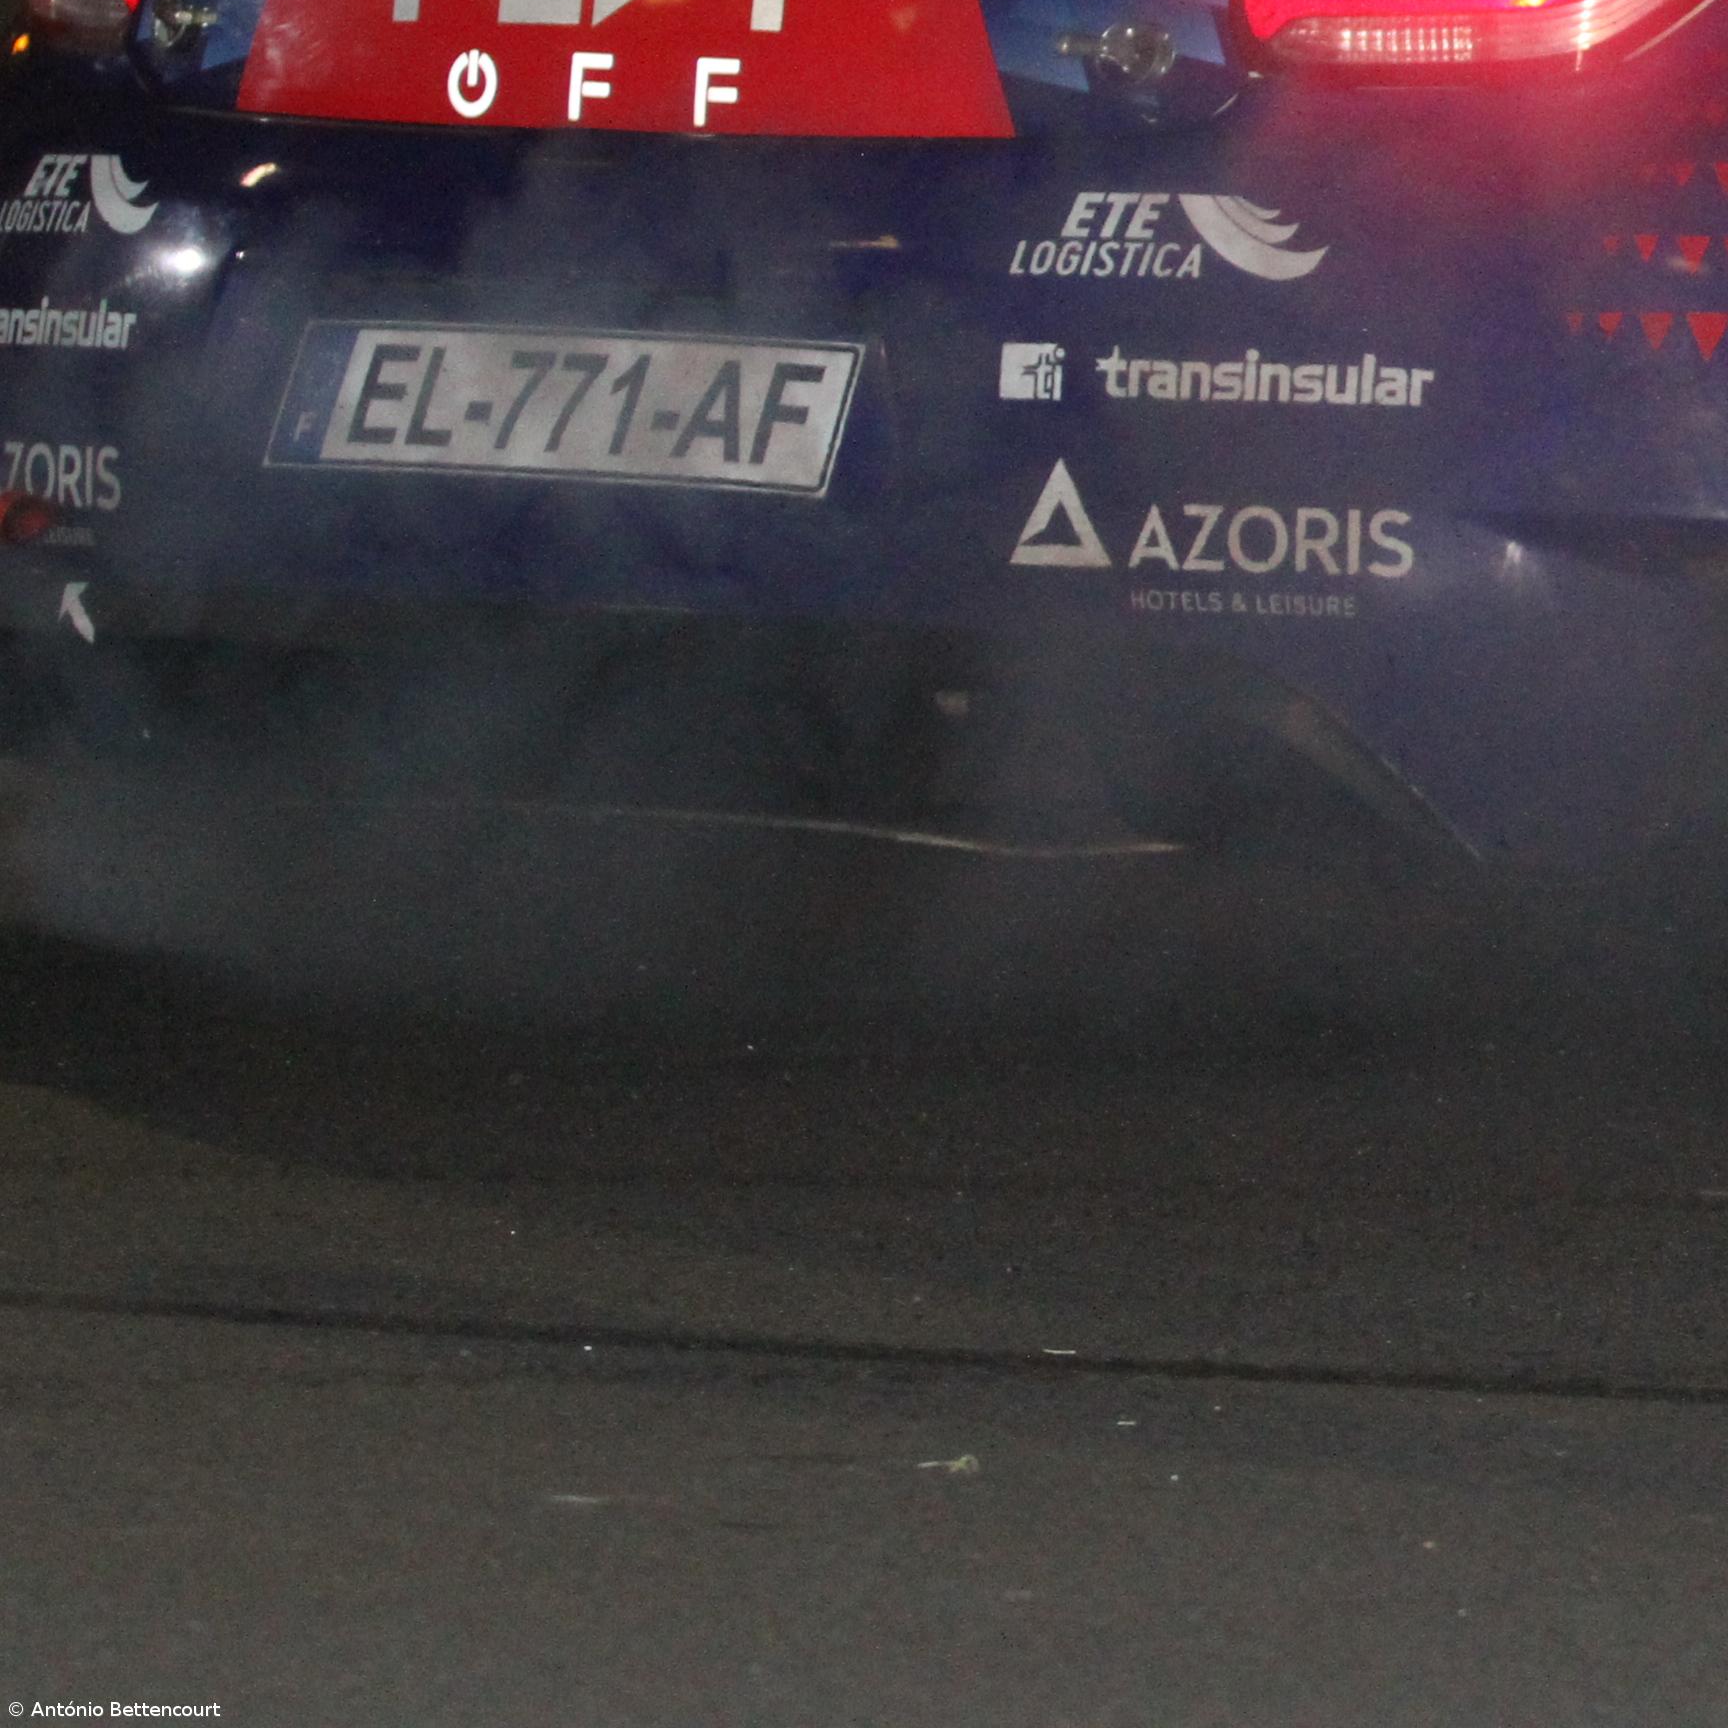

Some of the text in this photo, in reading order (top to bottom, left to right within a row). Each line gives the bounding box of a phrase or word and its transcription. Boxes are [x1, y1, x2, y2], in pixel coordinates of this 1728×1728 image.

[24, 153, 90, 198] ETE
[1060, 191, 1171, 240] ETE
[1009, 239, 1203, 279] LOGISTICA
[1096, 345, 1435, 407] transinsular
[346, 343, 828, 465] EL-771-AF
[1127, 503, 1416, 578] AZORIS
[1130, 589, 1223, 614] HOTELS
[1255, 592, 1357, 618] LEISURE
